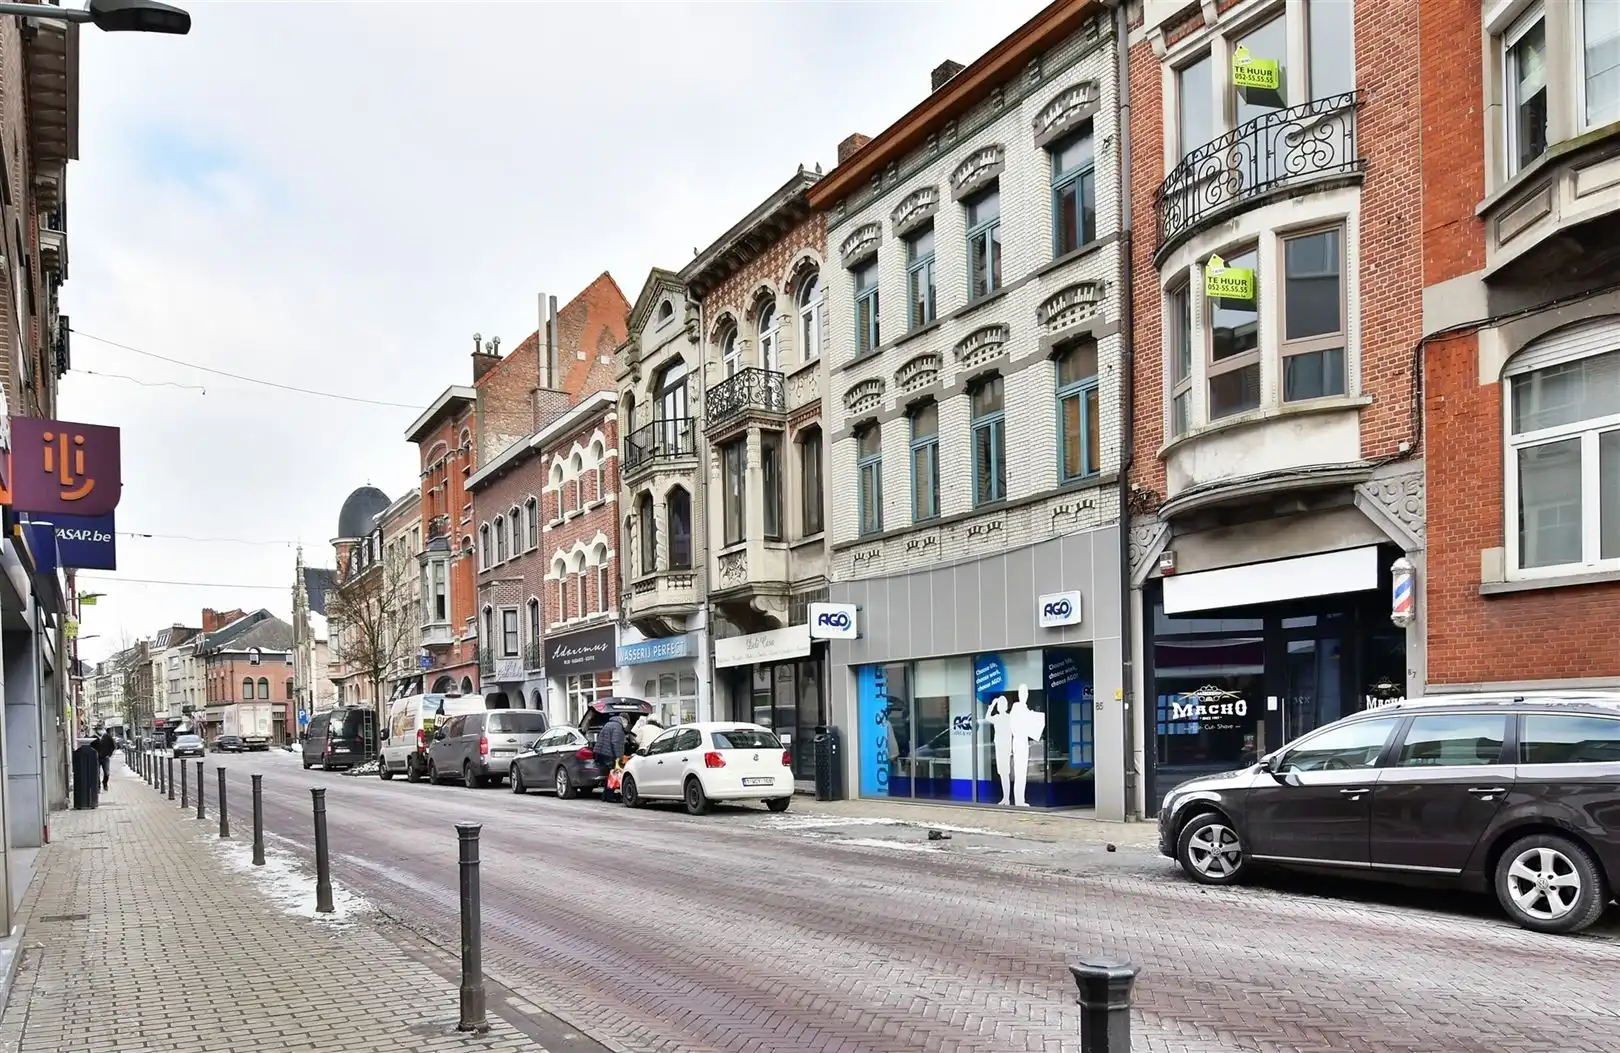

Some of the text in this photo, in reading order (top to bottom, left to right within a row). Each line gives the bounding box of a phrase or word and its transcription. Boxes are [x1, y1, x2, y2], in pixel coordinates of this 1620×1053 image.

[1247, 68, 1273, 76] HUUR
[1207, 276, 1247, 286] TE HUUR
[1043, 600, 1070, 617] AGO
[818, 612, 849, 627] AGO
[653, 641, 686, 656] PERFECT
[300, 710, 306, 719] P
[953, 715, 972, 730] AG
[876, 736, 888, 794] JOBS
